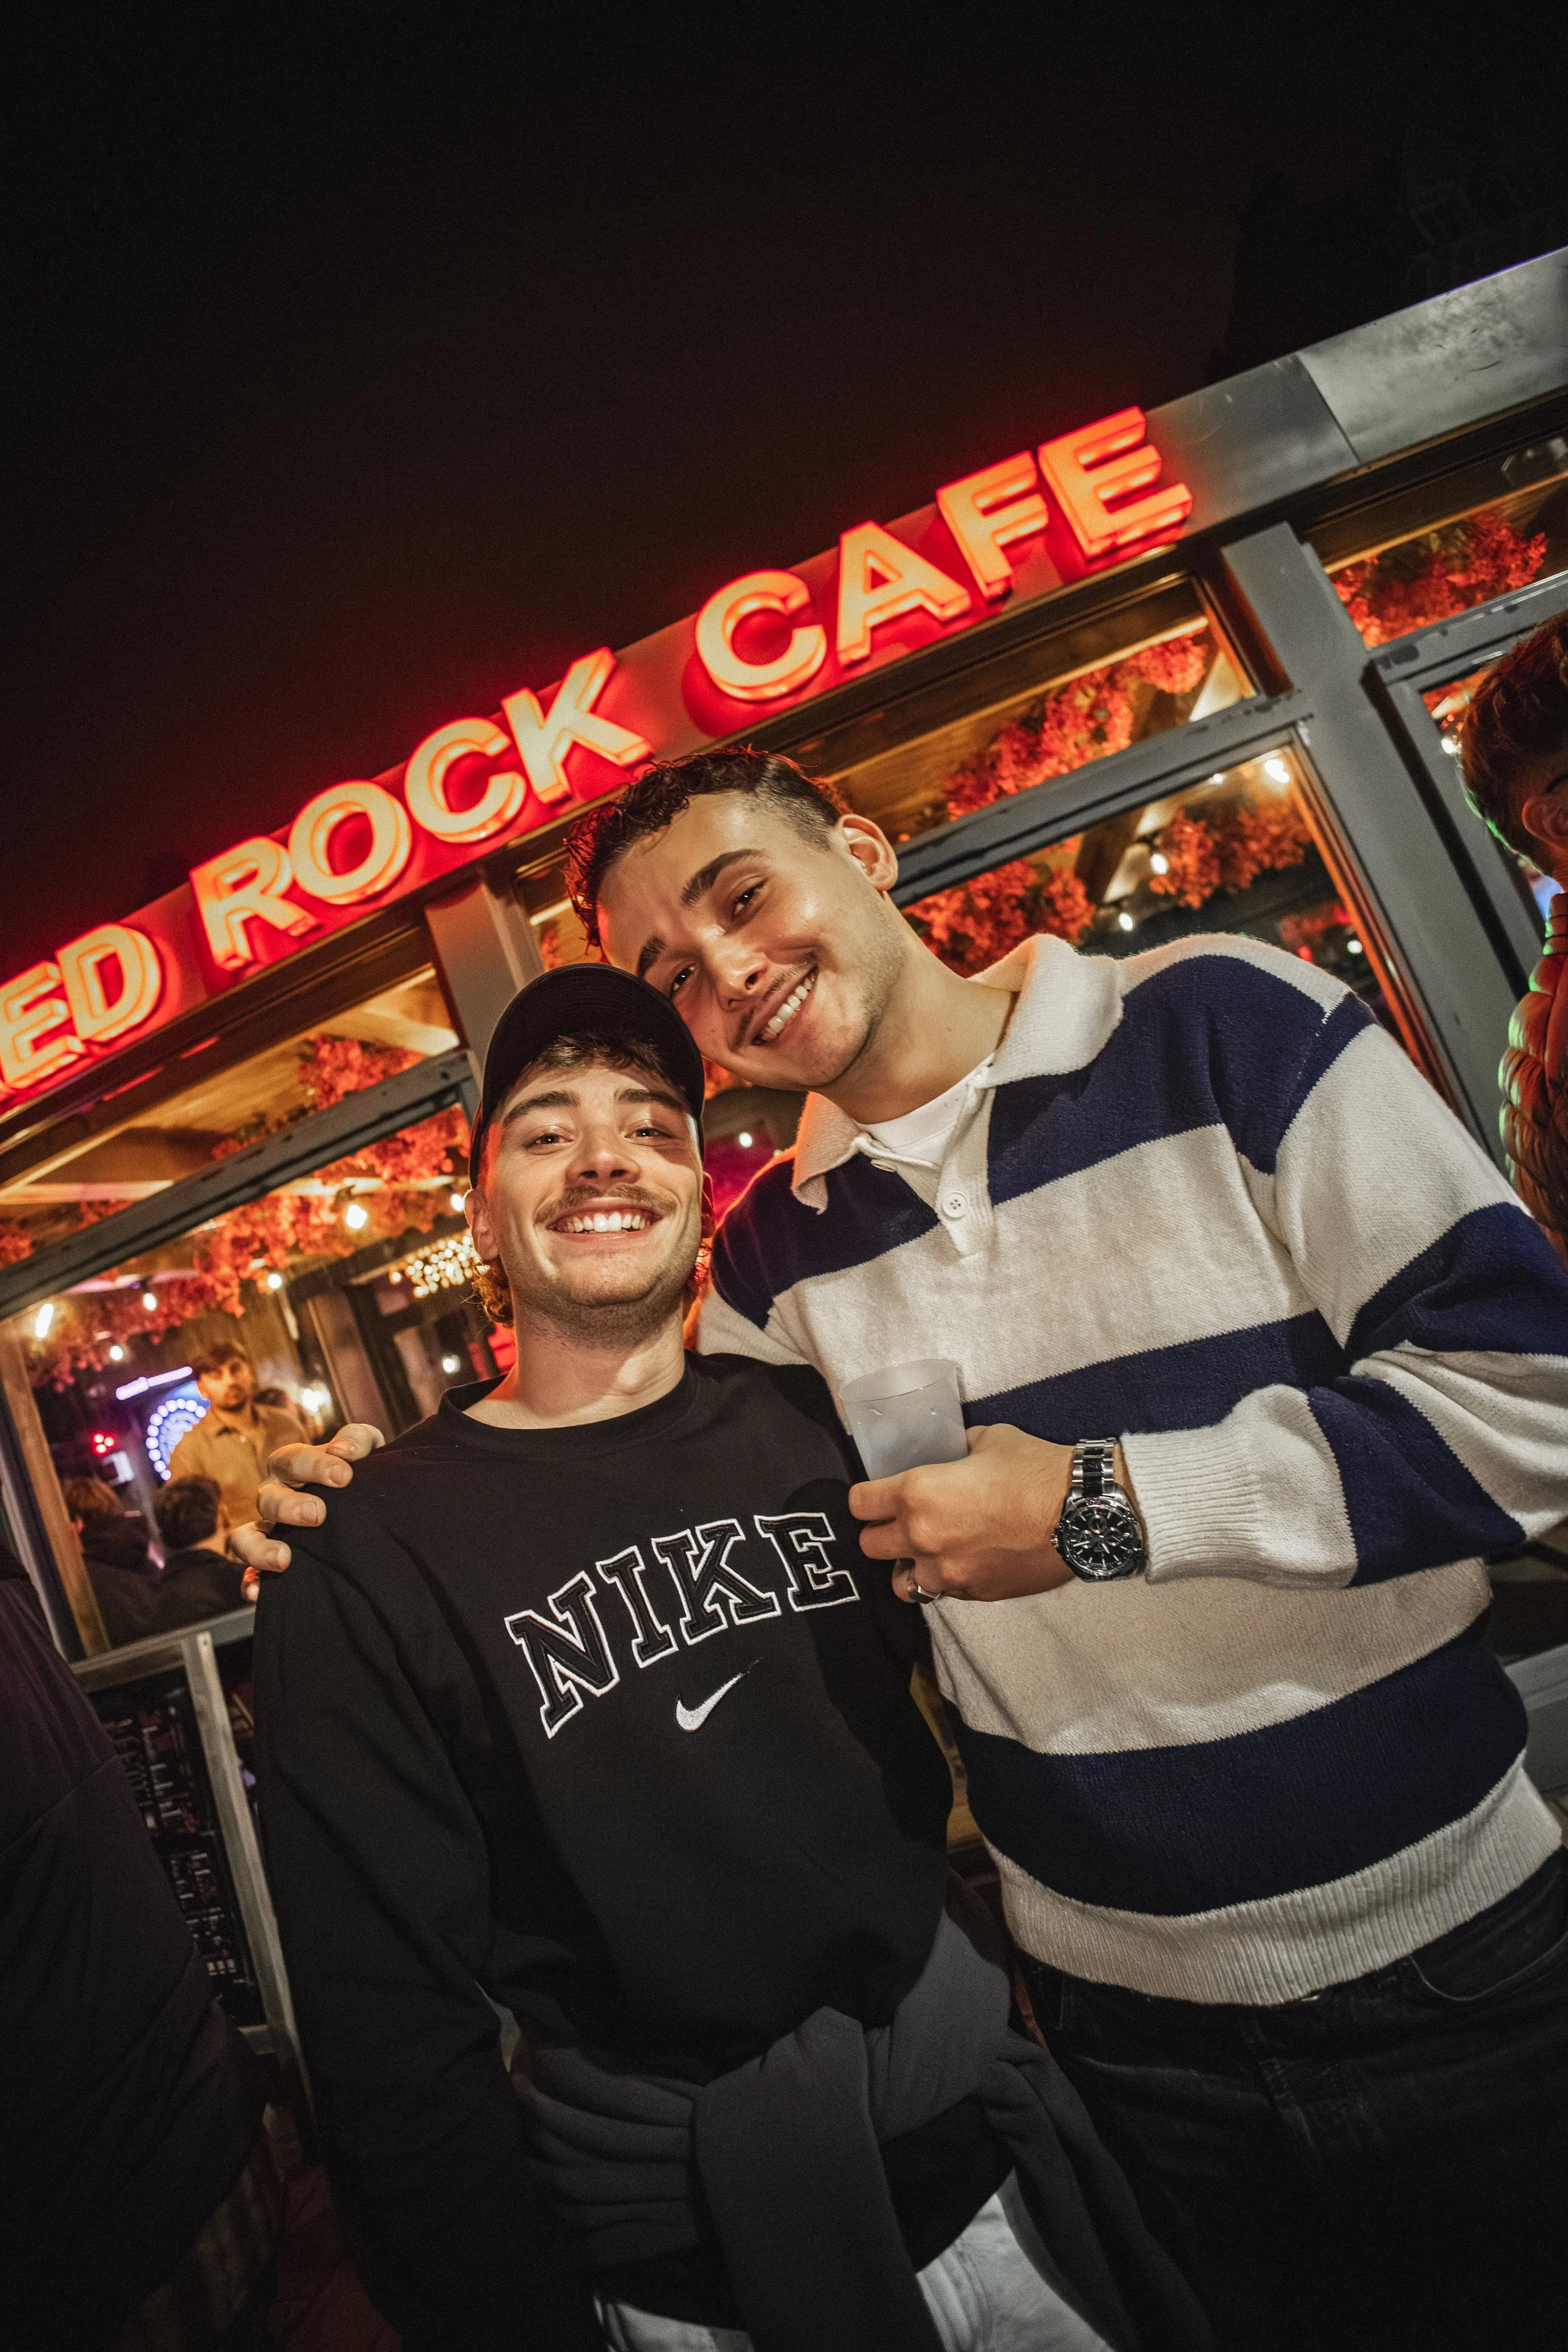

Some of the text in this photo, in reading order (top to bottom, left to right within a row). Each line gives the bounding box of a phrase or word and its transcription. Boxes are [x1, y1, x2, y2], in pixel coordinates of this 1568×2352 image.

[0, 405, 1193, 1091] ED ROCK CAFE
[504, 1512, 861, 1739] NIKE
